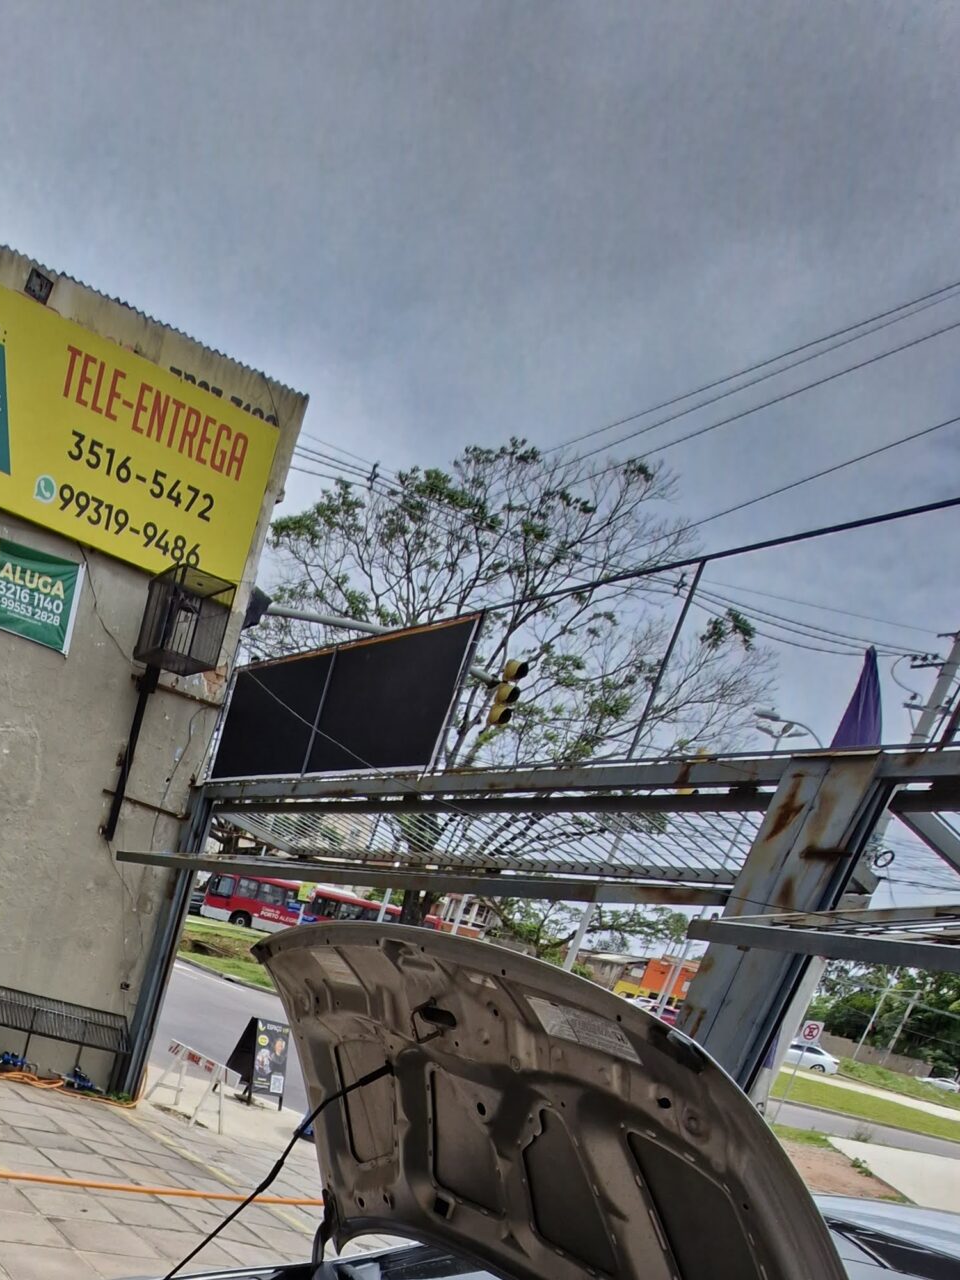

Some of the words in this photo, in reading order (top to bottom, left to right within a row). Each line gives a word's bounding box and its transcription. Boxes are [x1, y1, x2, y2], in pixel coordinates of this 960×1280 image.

[63, 345, 249, 481] TELE-ENTREGA
[67, 429, 215, 522] 3516-5472
[58, 483, 201, 567] 99319-9486
[0, 562, 65, 599] ALUGA
[0, 598, 32, 617] 99553
[34, 608, 61, 626] 2828
[33, 591, 63, 614] 1140
[260, 910, 279, 920] PORTO
